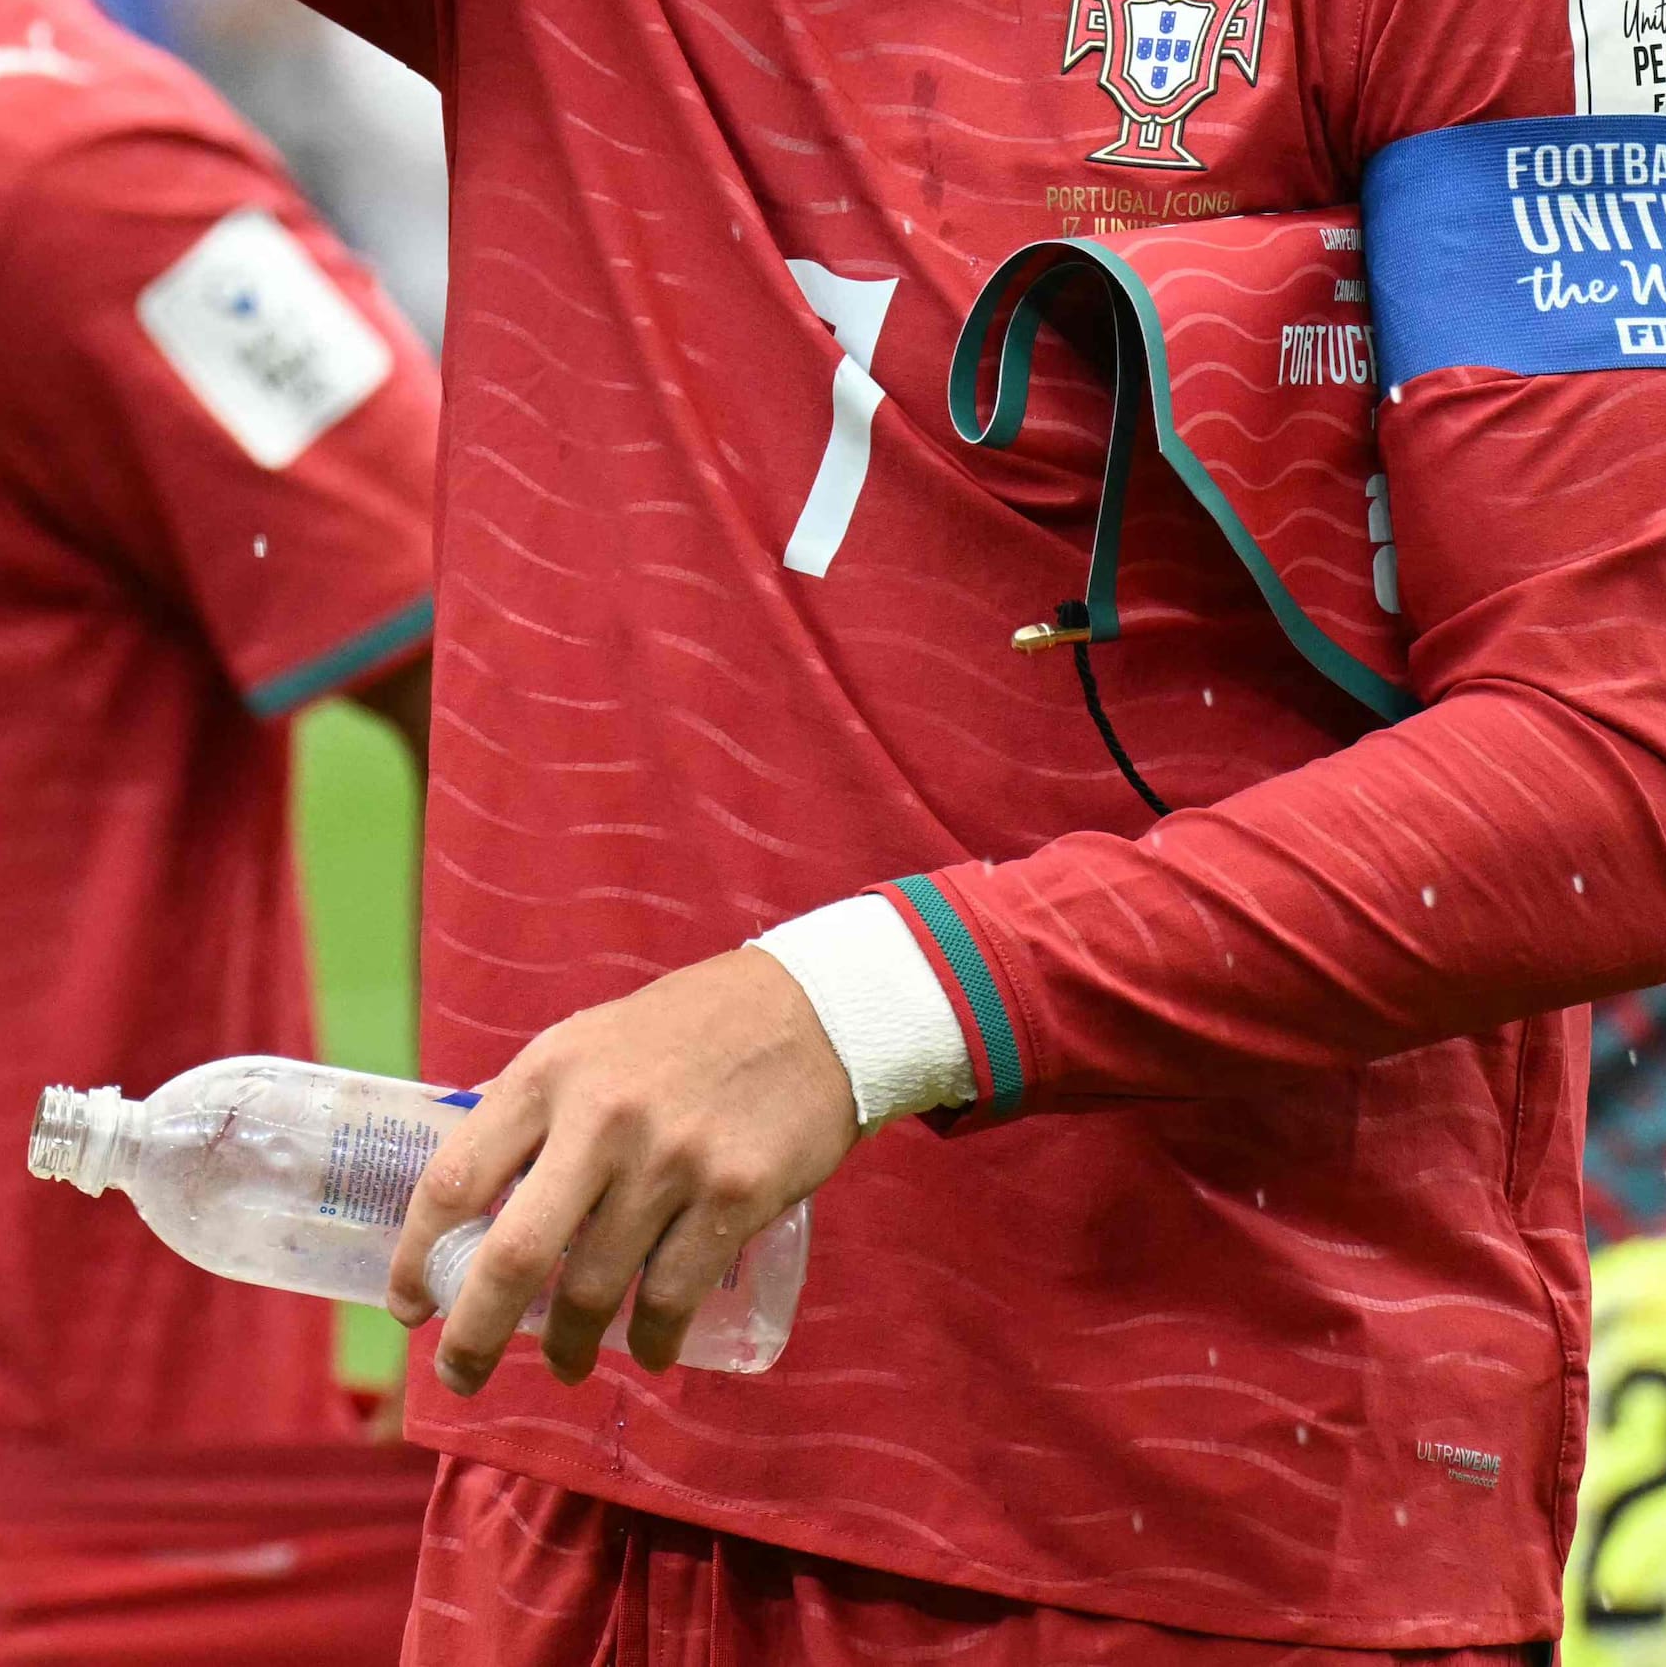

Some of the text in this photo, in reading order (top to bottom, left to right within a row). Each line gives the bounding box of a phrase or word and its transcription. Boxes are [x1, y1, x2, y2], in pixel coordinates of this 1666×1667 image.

[1516, 259, 1619, 313] the
[783, 258, 908, 579] 7
[1416, 1440, 1501, 1475] ULTRAWEAVE
